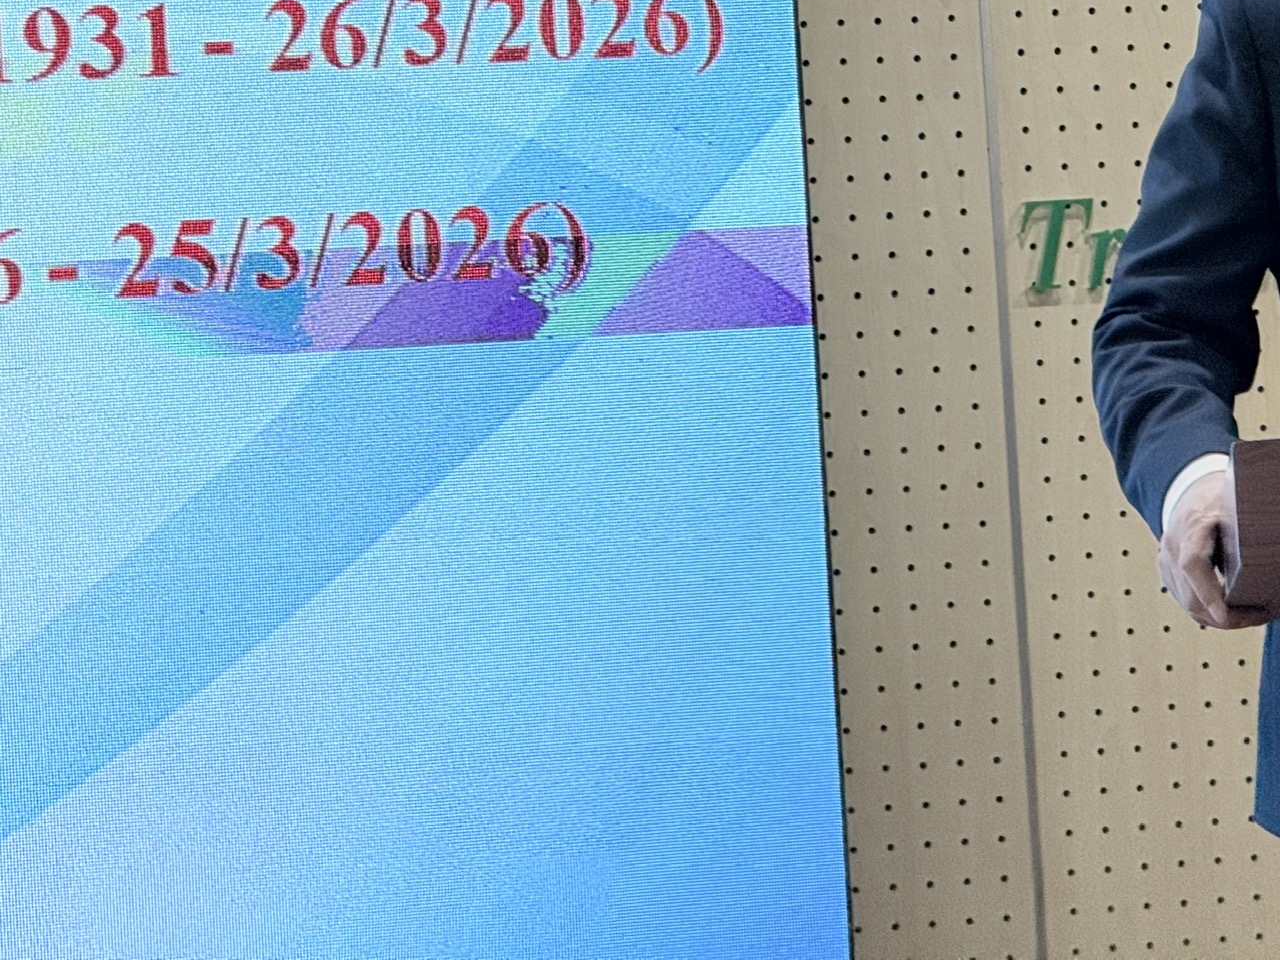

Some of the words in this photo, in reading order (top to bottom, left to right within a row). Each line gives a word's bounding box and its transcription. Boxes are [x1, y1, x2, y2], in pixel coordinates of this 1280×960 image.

[0, 2, 180, 84] 931
[203, 41, 235, 56] -
[48, 266, 79, 282] -
[114, 202, 592, 299] 25/3/2026)
